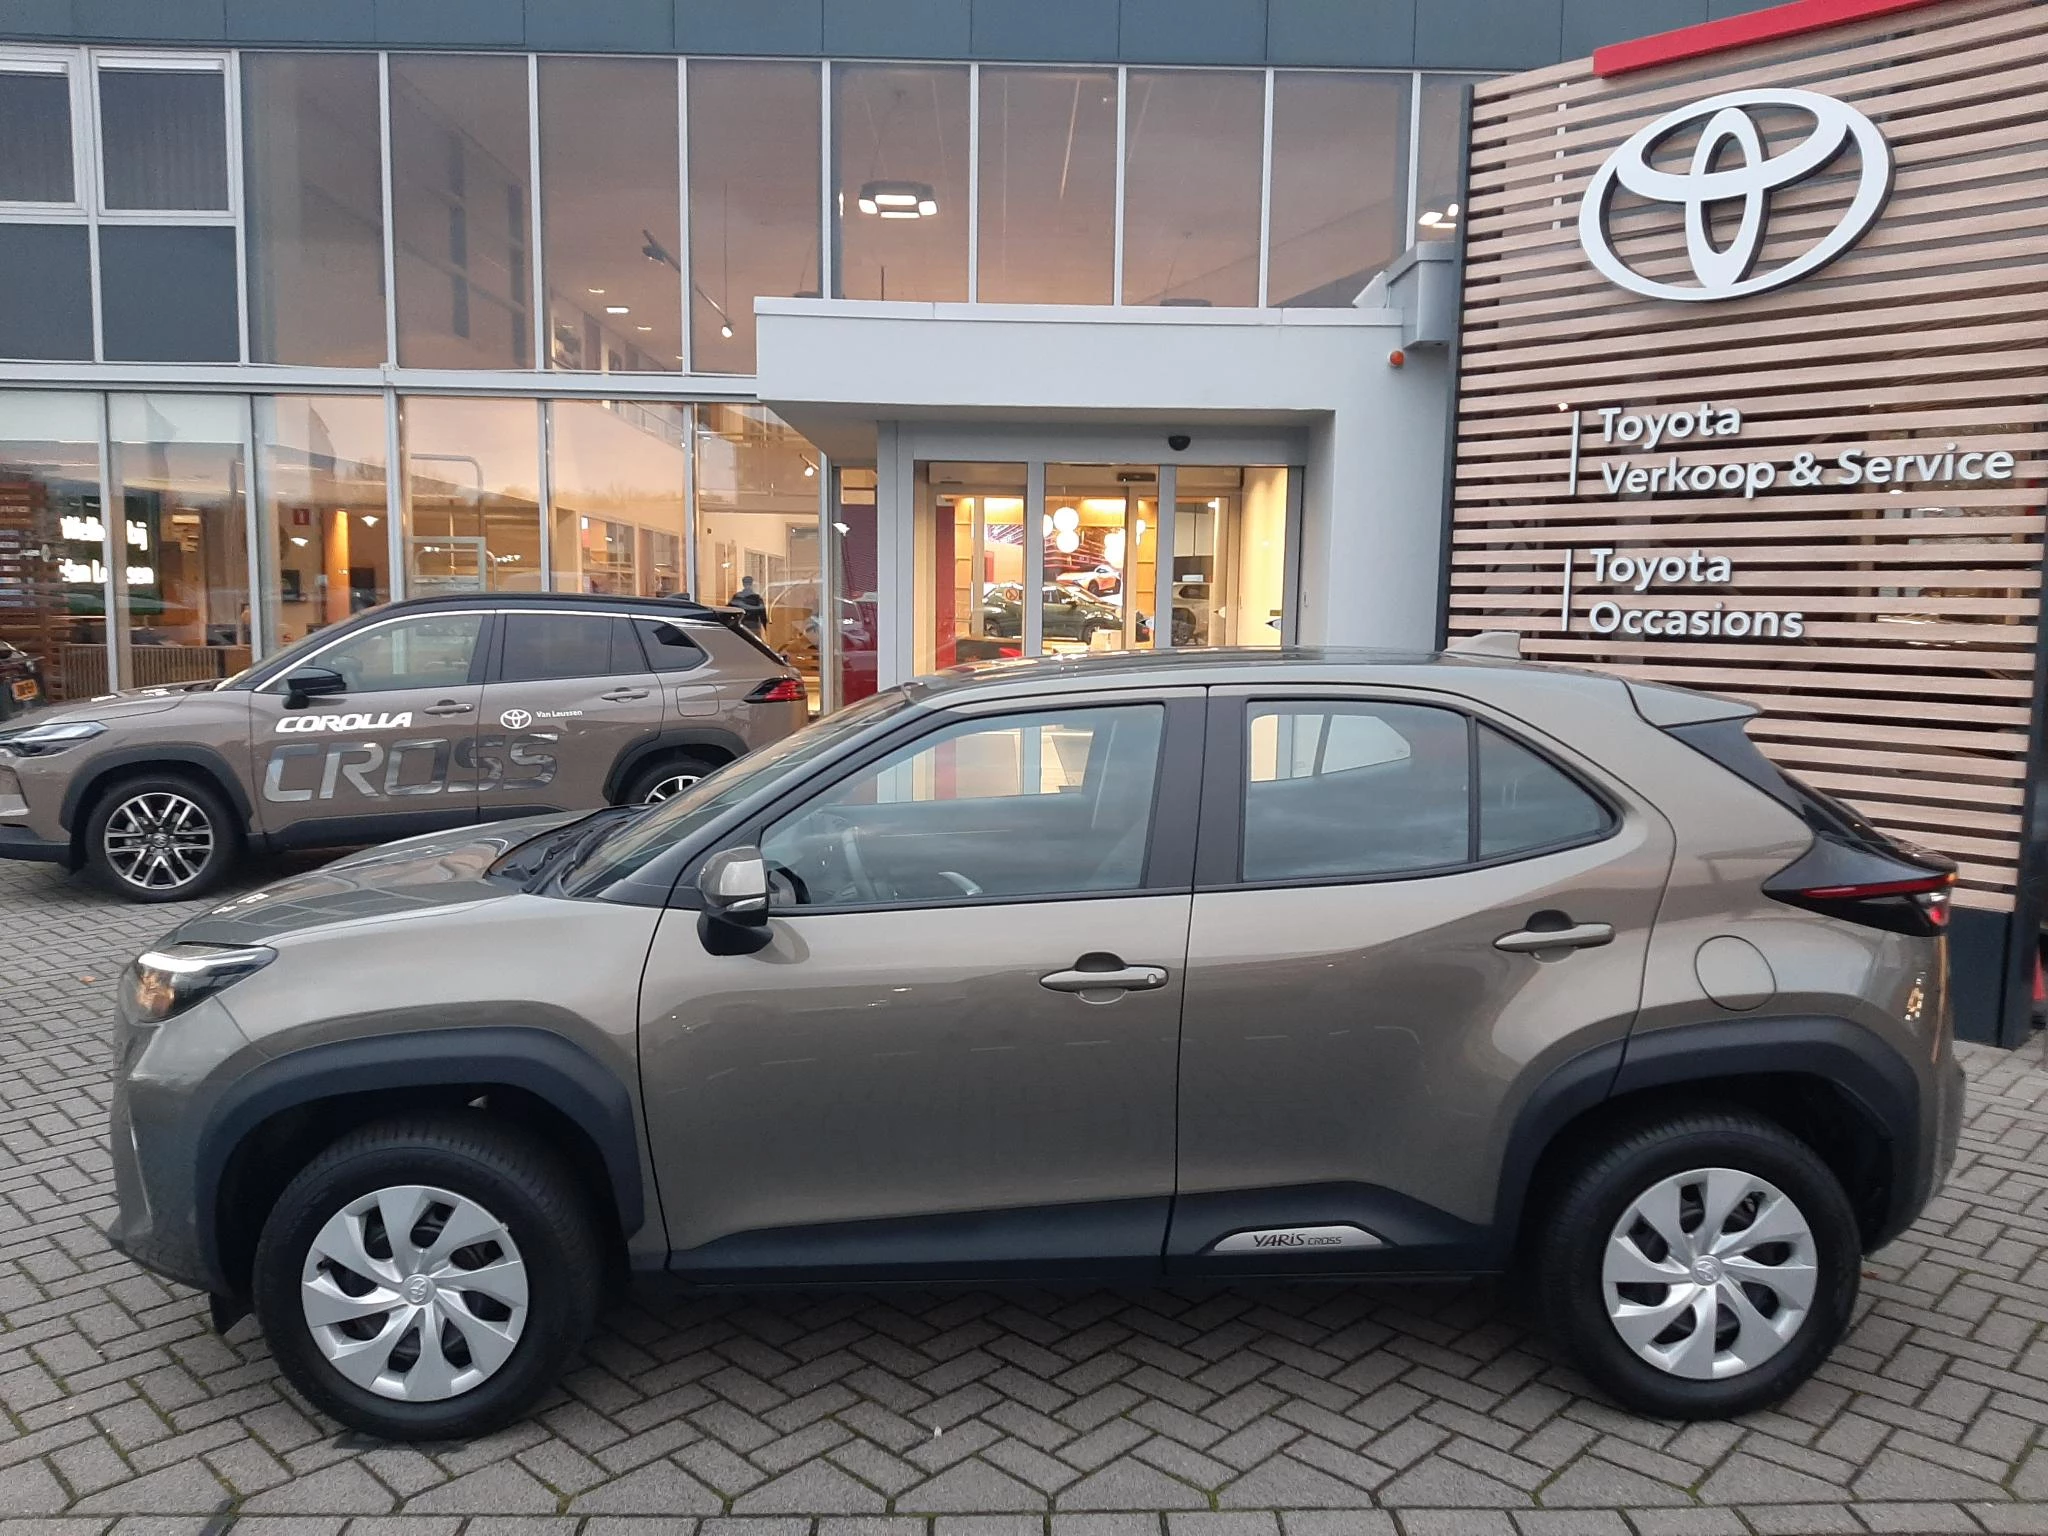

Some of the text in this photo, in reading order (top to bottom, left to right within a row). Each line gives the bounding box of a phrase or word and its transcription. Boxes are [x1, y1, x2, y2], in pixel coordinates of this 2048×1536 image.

[1598, 404, 1741, 449] Toyota
[1602, 442, 2015, 499] Verkoop & Service
[1591, 550, 1732, 591] Toyota
[1589, 602, 1804, 639] Occasions
[275, 711, 413, 732] COROLLA
[536, 711, 551, 719] Van
[263, 735, 558, 802] CROSS
[1307, 1236, 1342, 1246] CROSS
